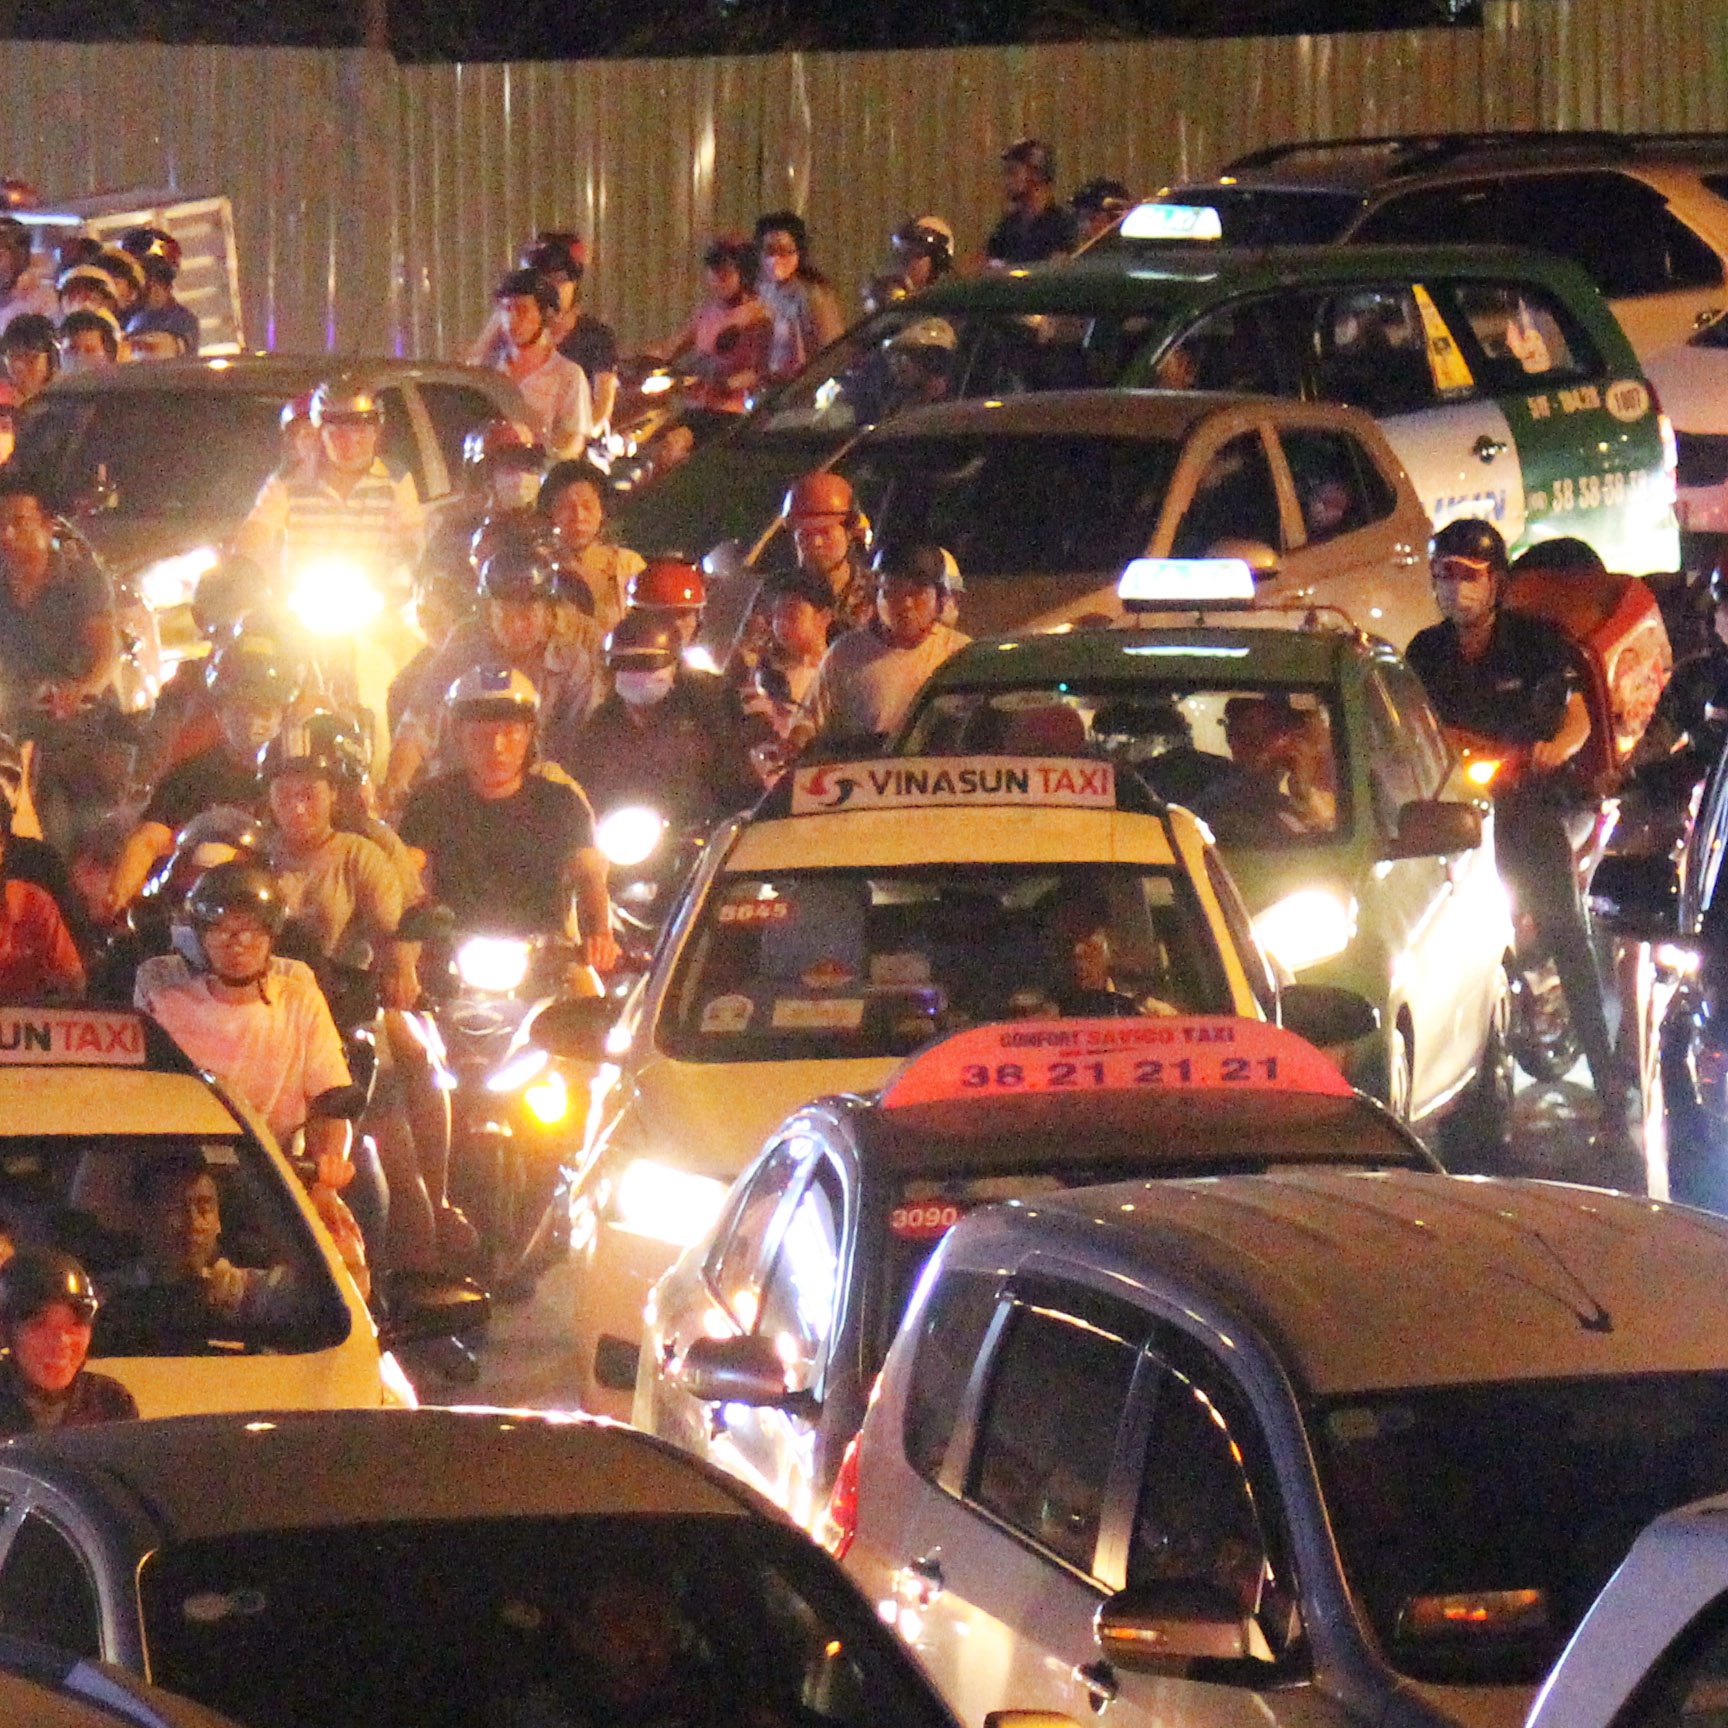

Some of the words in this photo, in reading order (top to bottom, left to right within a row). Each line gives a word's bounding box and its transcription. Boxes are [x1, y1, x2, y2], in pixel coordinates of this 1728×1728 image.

[868, 767, 1029, 797] VINASUN
[1038, 766, 1110, 796] TAXI
[57, 1020, 141, 1054] TAXI
[1183, 1026, 1235, 1043] TAXI
[1047, 1061, 1106, 1086] 21
[1134, 1059, 1191, 1084] 21
[1220, 1057, 1279, 1081] 21
[891, 1207, 958, 1229] 3090
